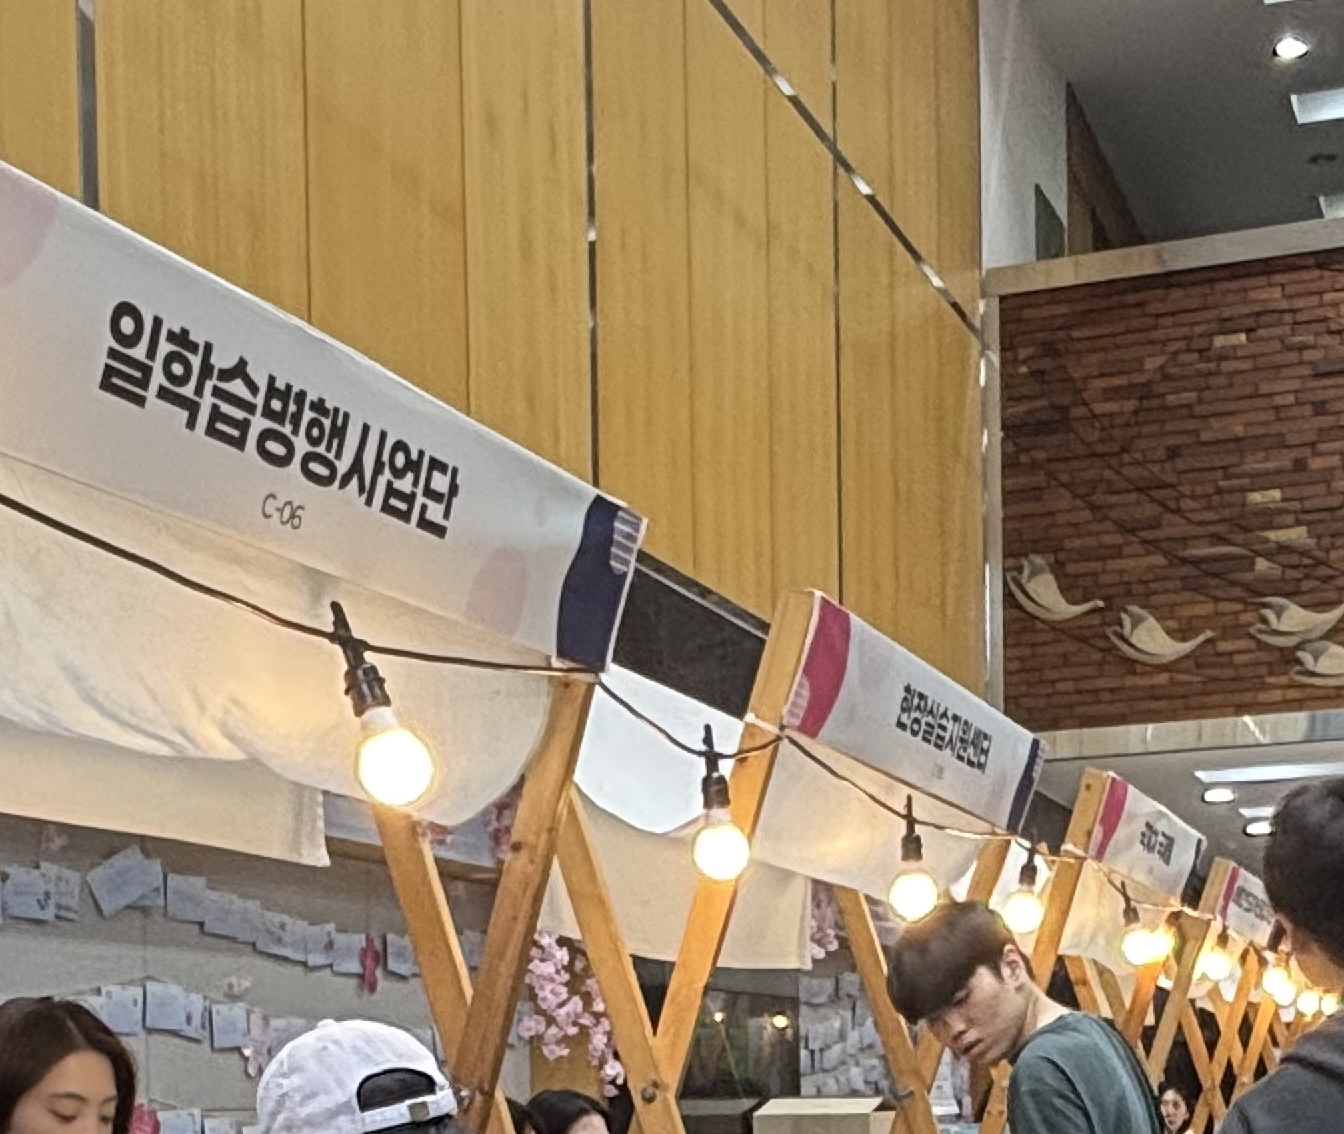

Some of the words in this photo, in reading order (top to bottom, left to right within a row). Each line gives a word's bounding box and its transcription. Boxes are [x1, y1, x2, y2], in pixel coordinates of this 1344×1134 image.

[98, 299, 460, 540] 일학습병행사업단
[260, 492, 306, 531] C-06
[895, 682, 993, 775] 현장실습지원센터
